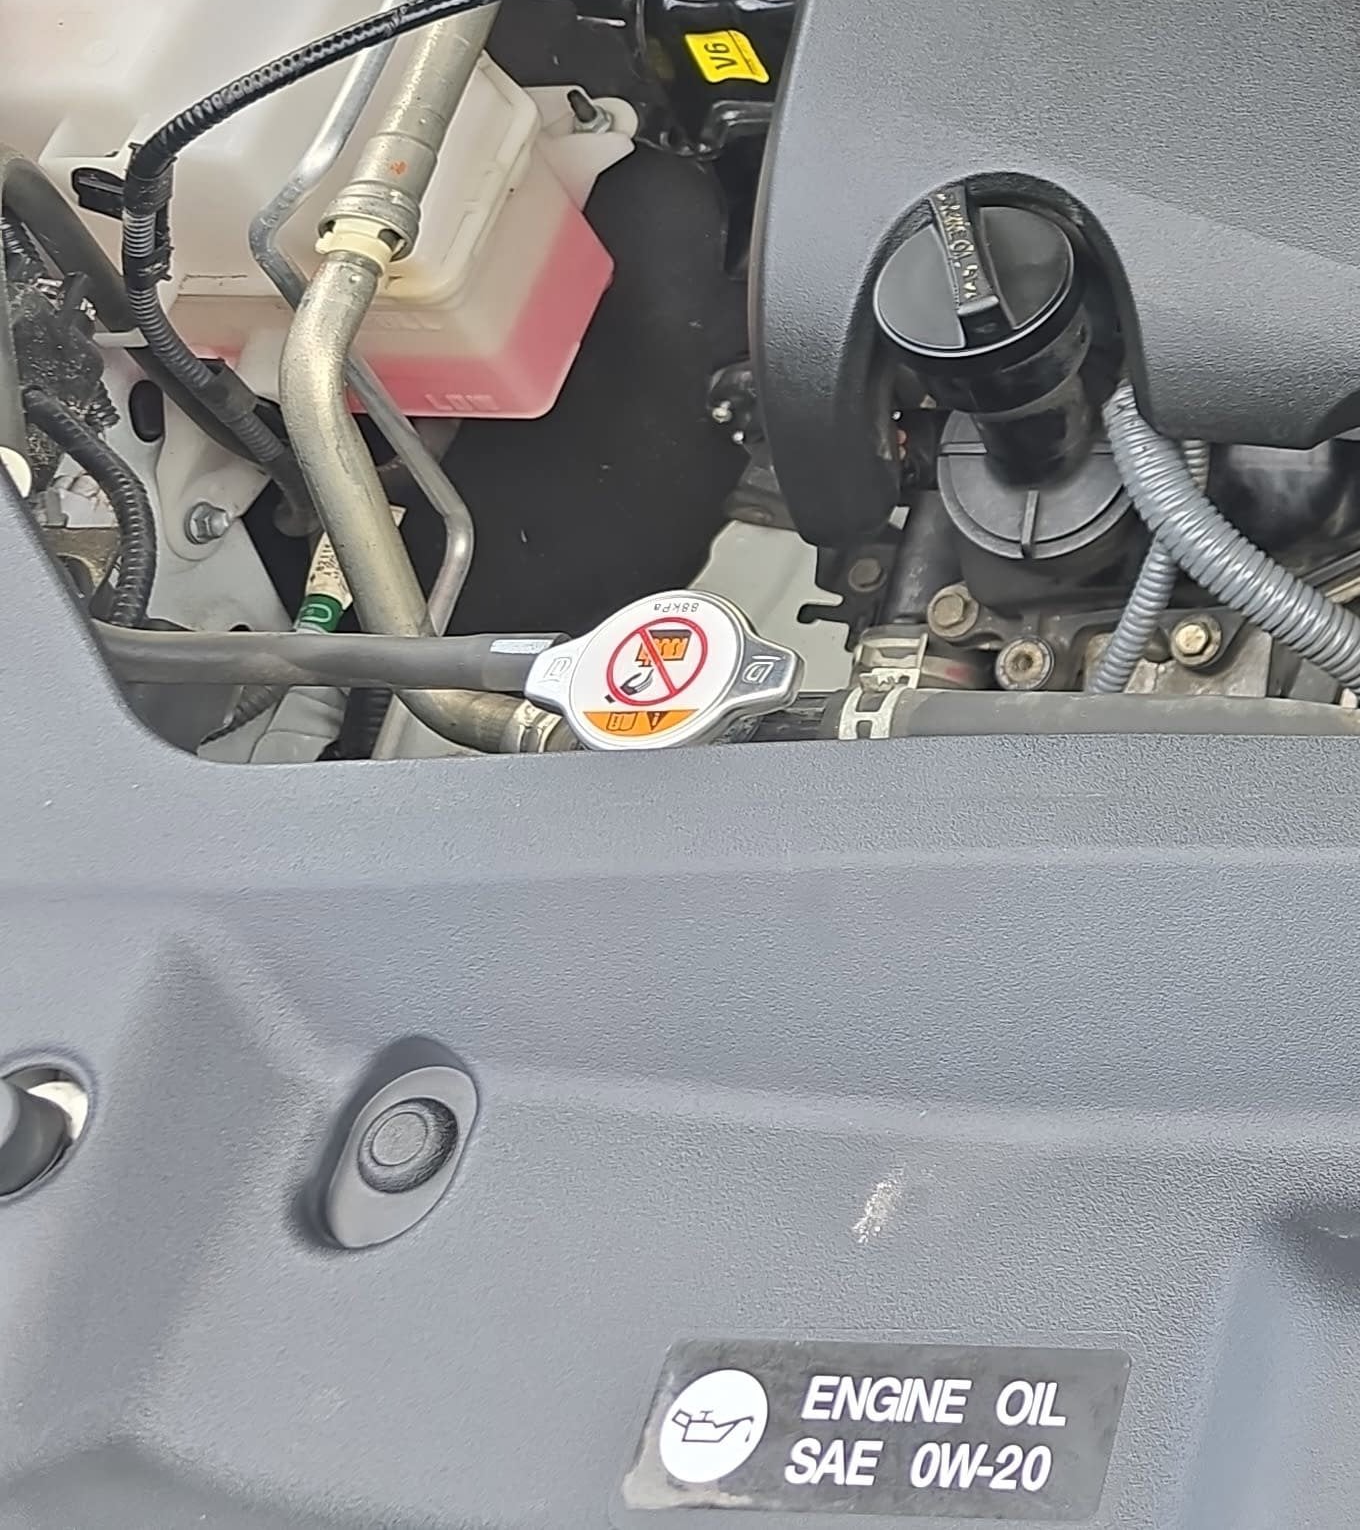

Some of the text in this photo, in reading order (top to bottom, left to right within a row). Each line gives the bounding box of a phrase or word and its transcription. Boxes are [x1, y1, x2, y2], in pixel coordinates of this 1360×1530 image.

[704, 43, 738, 70] V6
[652, 602, 700, 614] 88kPa
[800, 1375, 1067, 1427] ENGINE OIL
[784, 1439, 1052, 1492] SAE 0W-20
